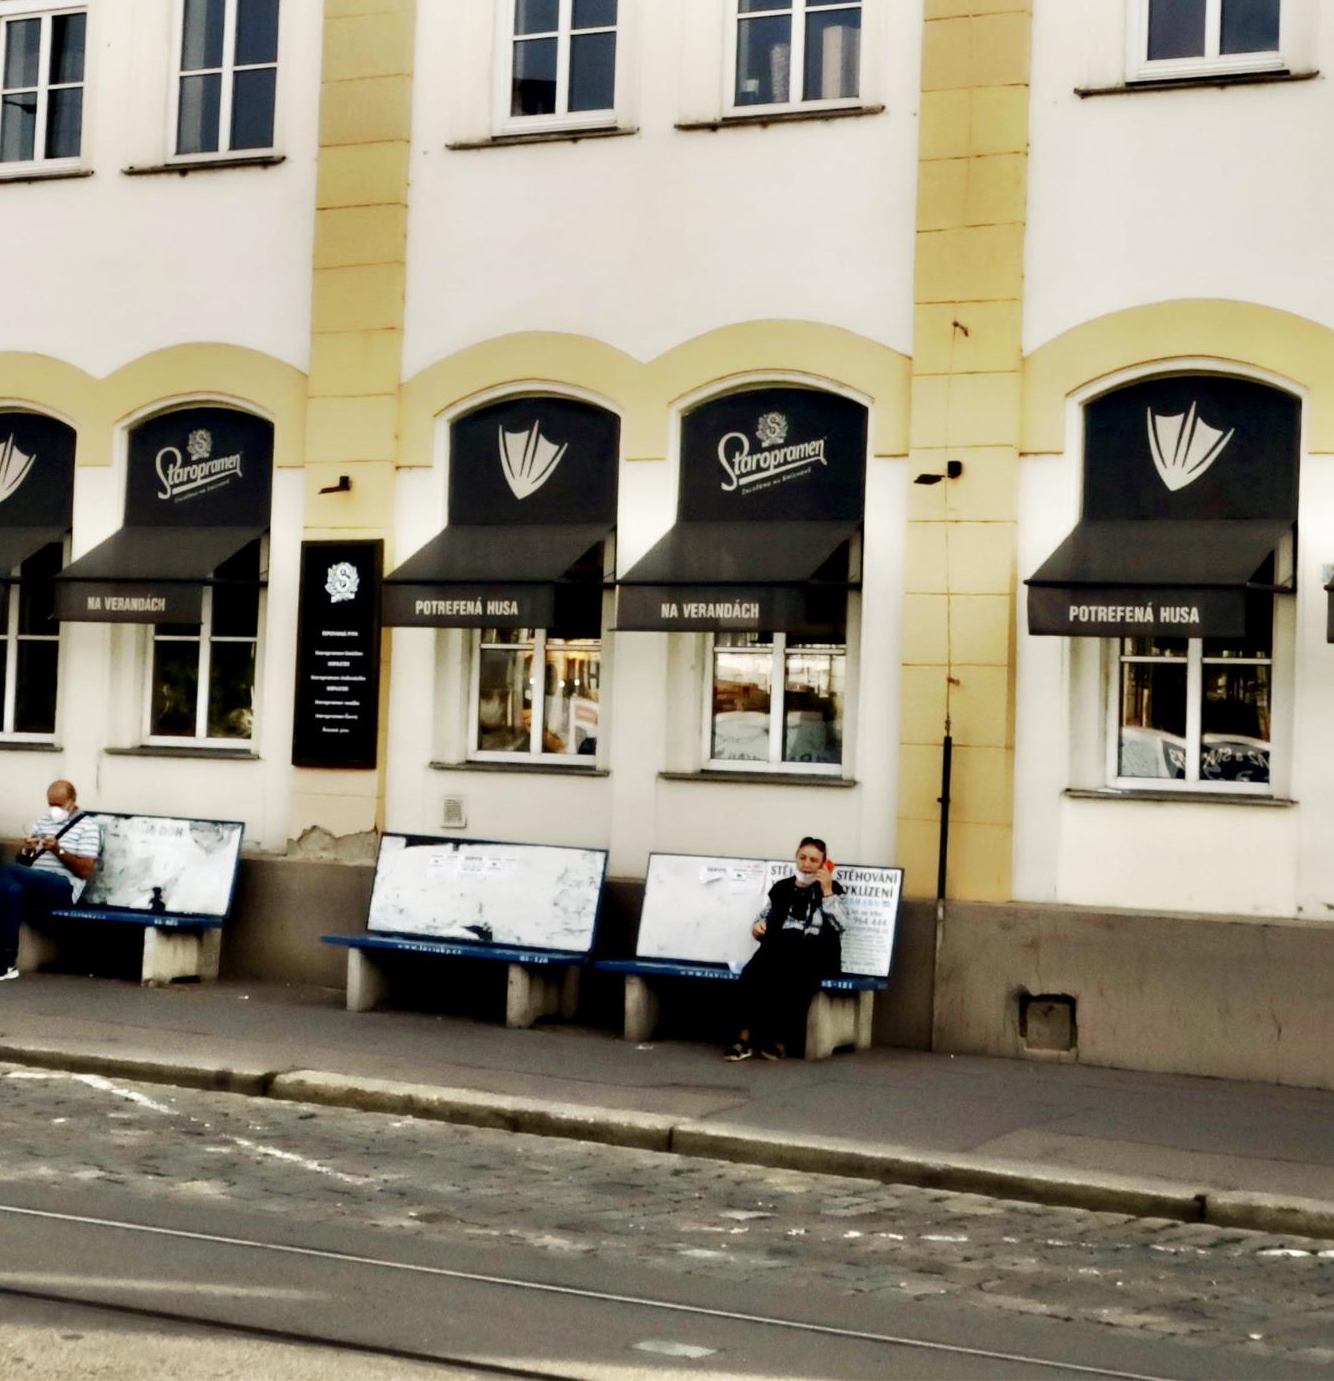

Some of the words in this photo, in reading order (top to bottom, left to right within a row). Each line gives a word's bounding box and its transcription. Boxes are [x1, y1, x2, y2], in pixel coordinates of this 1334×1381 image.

[717, 432, 827, 491] Staropramen
[155, 446, 243, 499] Staropramen
[87, 596, 101, 610] NA
[104, 594, 165, 612] VERANDÁCH
[415, 597, 483, 615] POTREFENÁ
[486, 600, 519, 615] HUSA
[661, 603, 679, 618] NA
[682, 599, 760, 619] VERANDÁCH
[1069, 602, 1154, 623] POTREFENÁ
[1159, 606, 1200, 624] HUSA
[836, 868, 898, 885] STĚHOVÁNÍ
